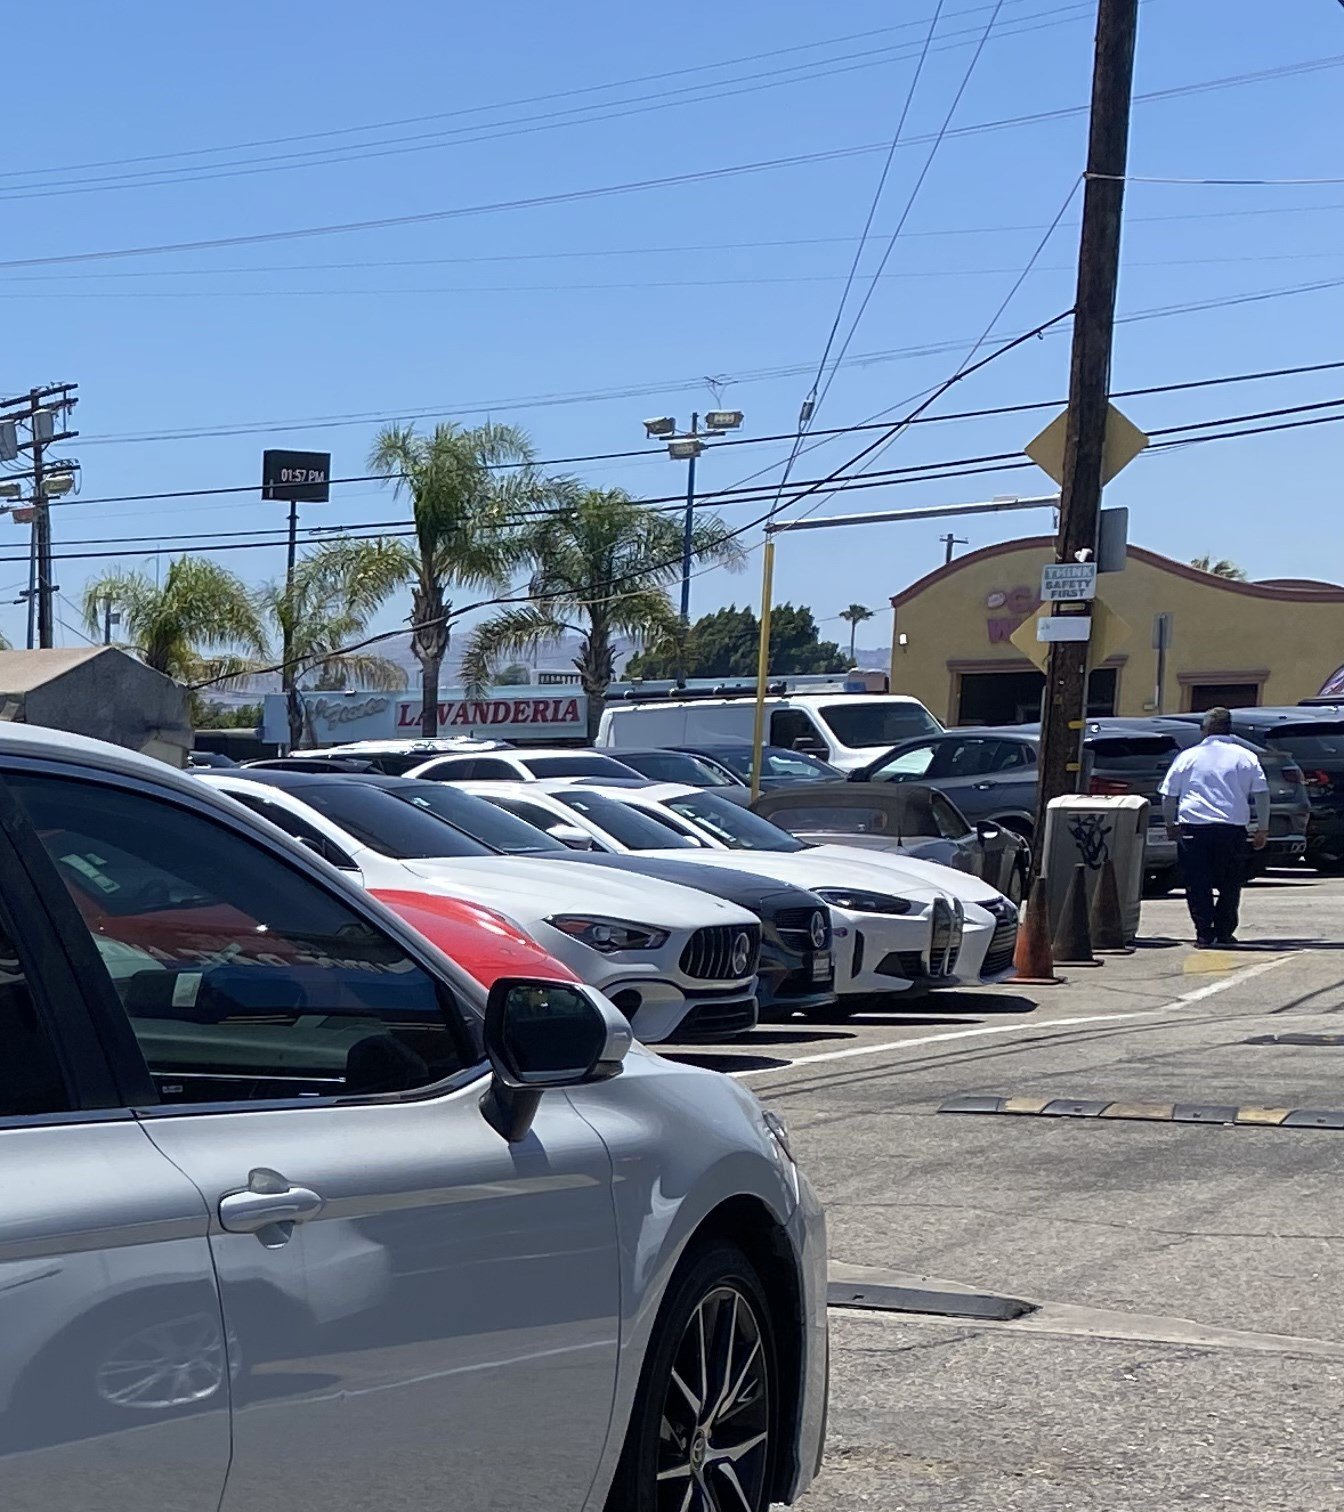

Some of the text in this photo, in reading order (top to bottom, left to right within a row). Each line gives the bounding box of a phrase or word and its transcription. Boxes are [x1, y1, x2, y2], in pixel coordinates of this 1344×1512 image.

[281, 468, 325, 483] 01:57 PM
[1046, 566, 1092, 578] THINK
[1045, 579, 1092, 590] SAFETY
[1050, 589, 1086, 599] FIRST
